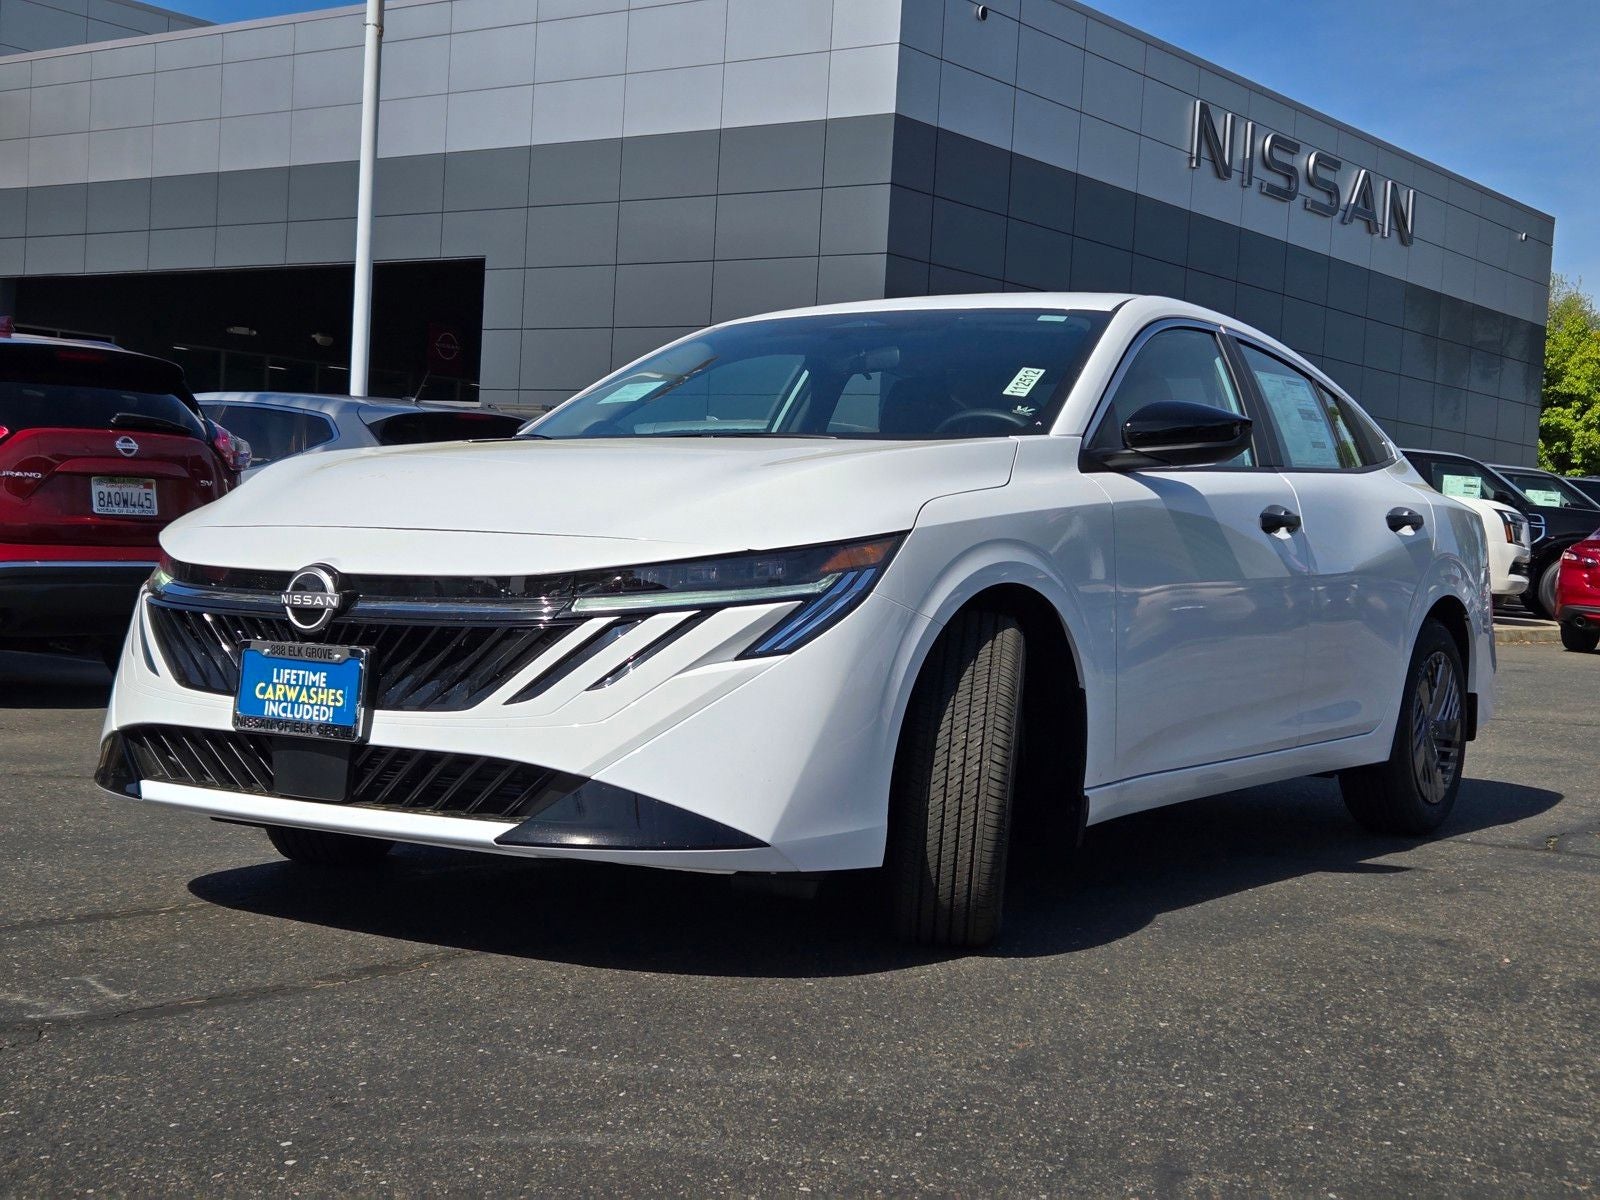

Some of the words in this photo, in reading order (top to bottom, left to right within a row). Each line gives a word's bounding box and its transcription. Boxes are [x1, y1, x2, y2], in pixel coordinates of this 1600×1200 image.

[1189, 100, 1416, 247] NISSAN
[1010, 369, 1041, 394] 112512
[200, 479, 213, 487] SV
[97, 490, 152, 509] 8AQW445
[281, 594, 337, 606] NISSAN
[270, 644, 286, 656] 888
[288, 646, 303, 657] ELK
[305, 648, 333, 660] GROVE
[273, 668, 327, 687] LIFETIME
[255, 682, 344, 707] CARWASHES
[264, 700, 333, 722] INCLUDED!
[237, 715, 272, 729] NISSAN
[293, 722, 313, 734] ELK
